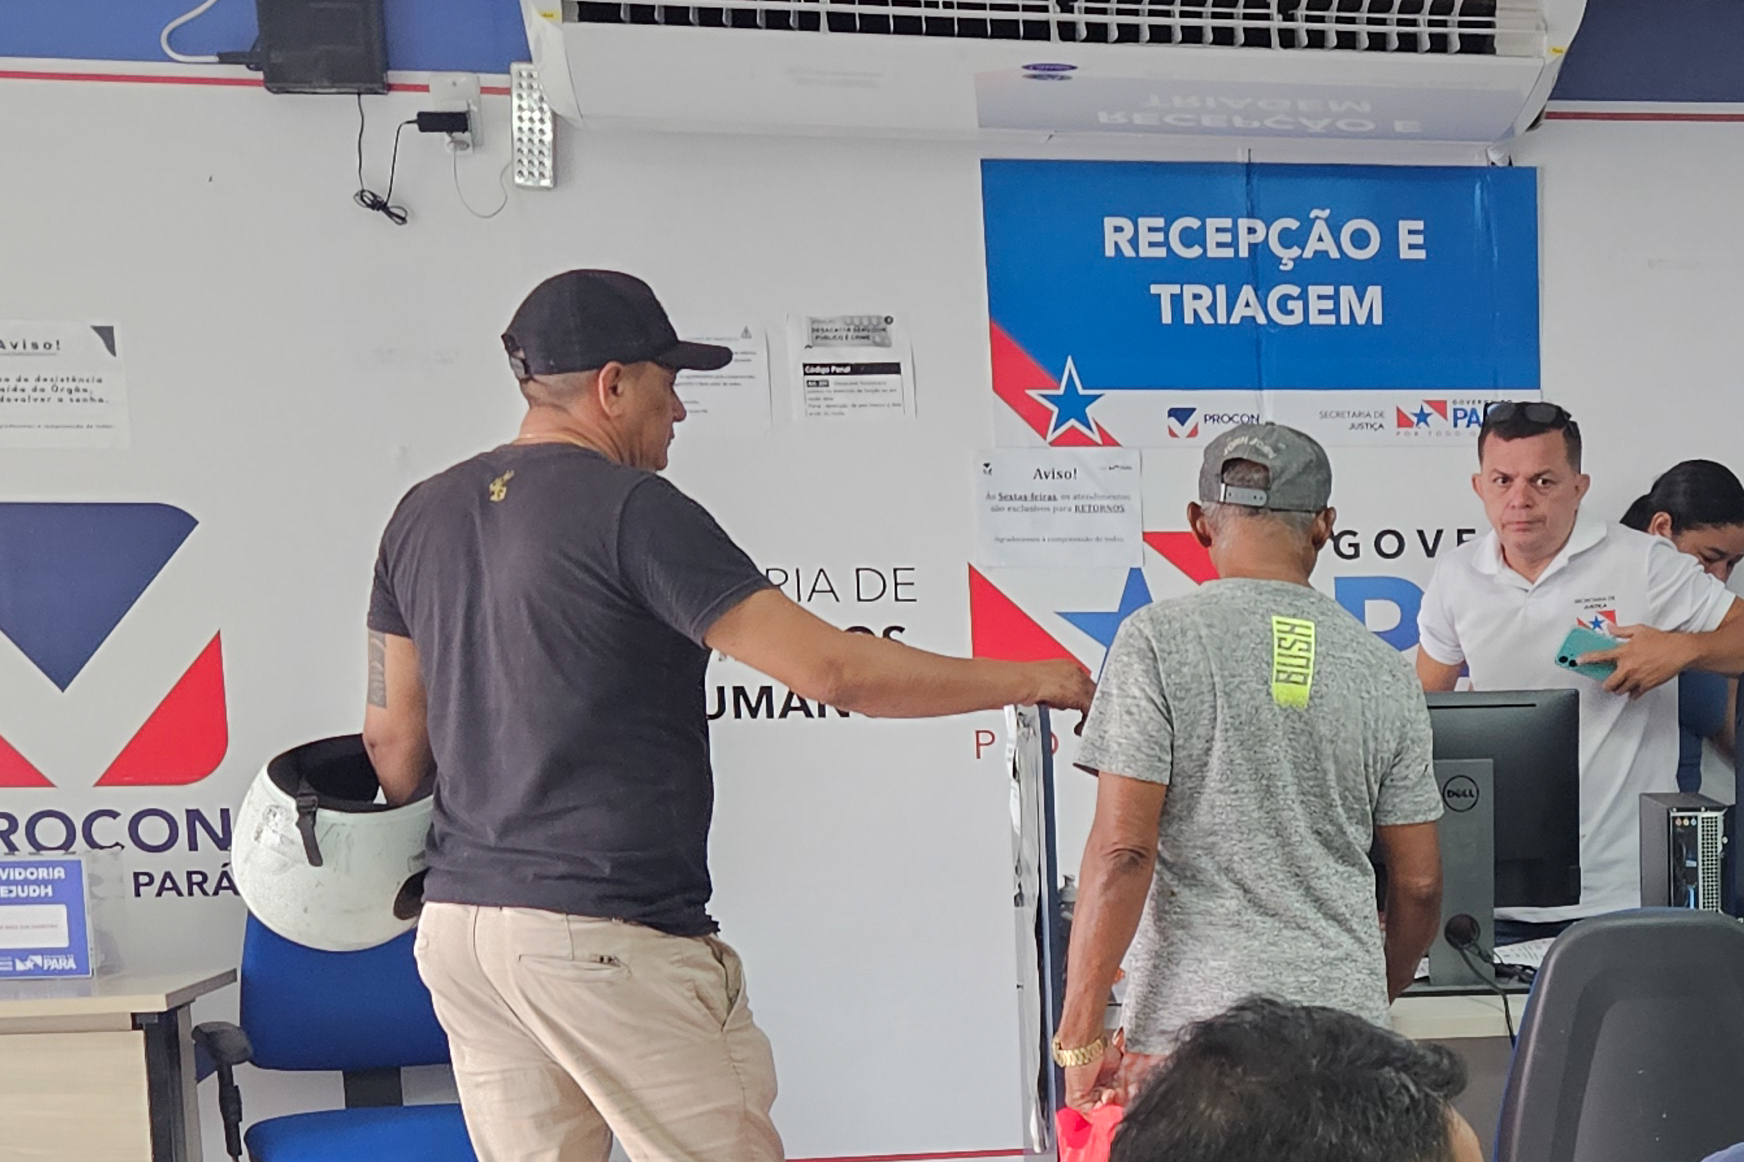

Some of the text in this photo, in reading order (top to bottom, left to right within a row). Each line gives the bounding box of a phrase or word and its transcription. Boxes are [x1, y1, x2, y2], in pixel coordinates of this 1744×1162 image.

[1103, 209, 1426, 270] RECEPÇÃO E
[1150, 283, 1384, 325] TRIAGEM
[1203, 413, 1260, 424] PROCON
[1349, 421, 1385, 431] JUSTIÇA
[1033, 467, 1078, 480] Aviso!
[856, 567, 917, 603] DE
[1446, 787, 1475, 799] DELL
[133, 862, 241, 898] PARÁ
